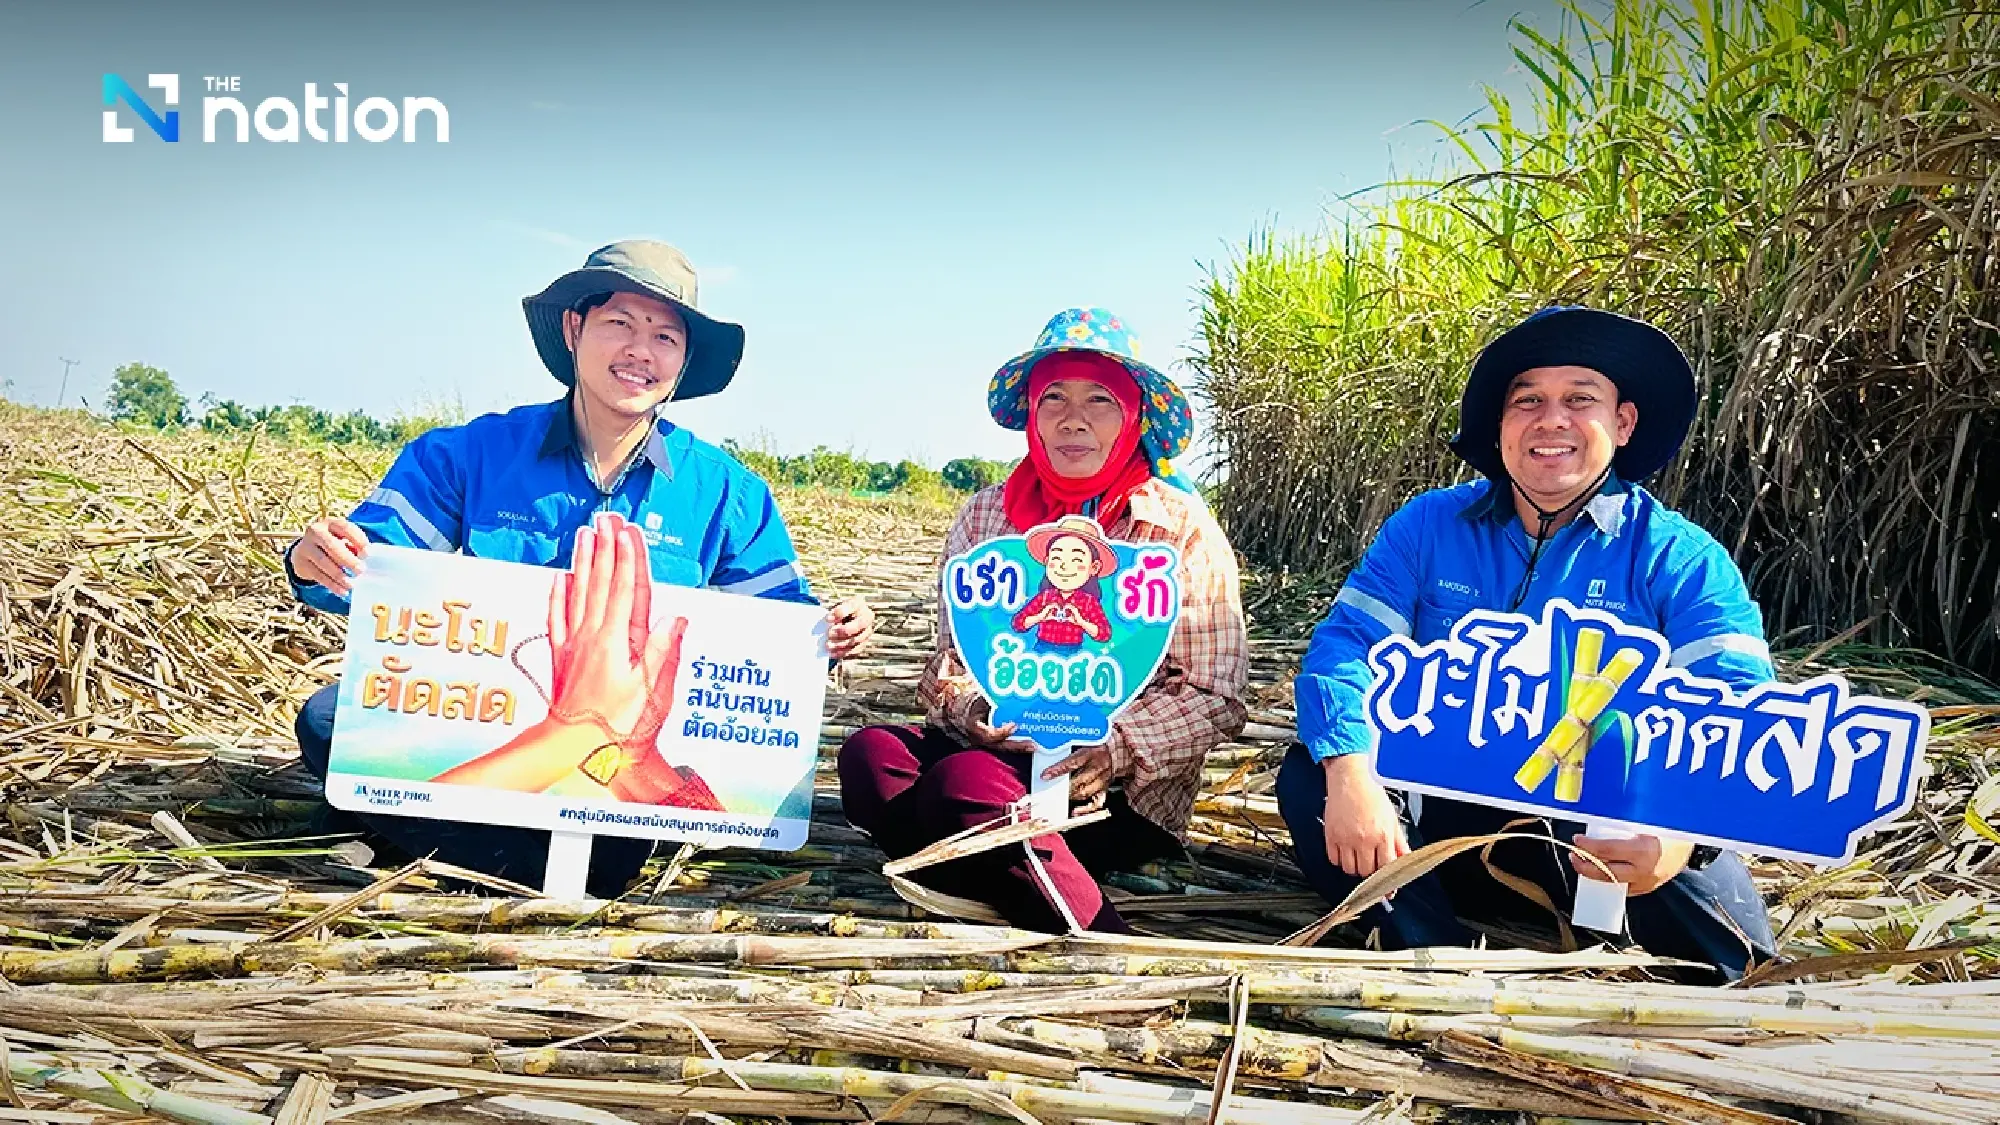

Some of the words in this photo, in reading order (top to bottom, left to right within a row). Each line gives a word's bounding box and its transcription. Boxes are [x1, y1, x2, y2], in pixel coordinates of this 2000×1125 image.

[954, 556, 1018, 604] เรา
[372, 600, 509, 657] นะโม
[362, 654, 516, 726] ตัดสด
[691, 654, 772, 687] ร่วมกัน
[994, 638, 1117, 698] อ้อยสด
[686, 682, 791, 724] สนับสนุน
[1377, 622, 1548, 748] นะโม
[1634, 682, 1912, 811] ตัดสด
[682, 711, 800, 749] ตัดอ้อยสด
[371, 788, 401, 799] MITR
[403, 790, 433, 802] PHOL
